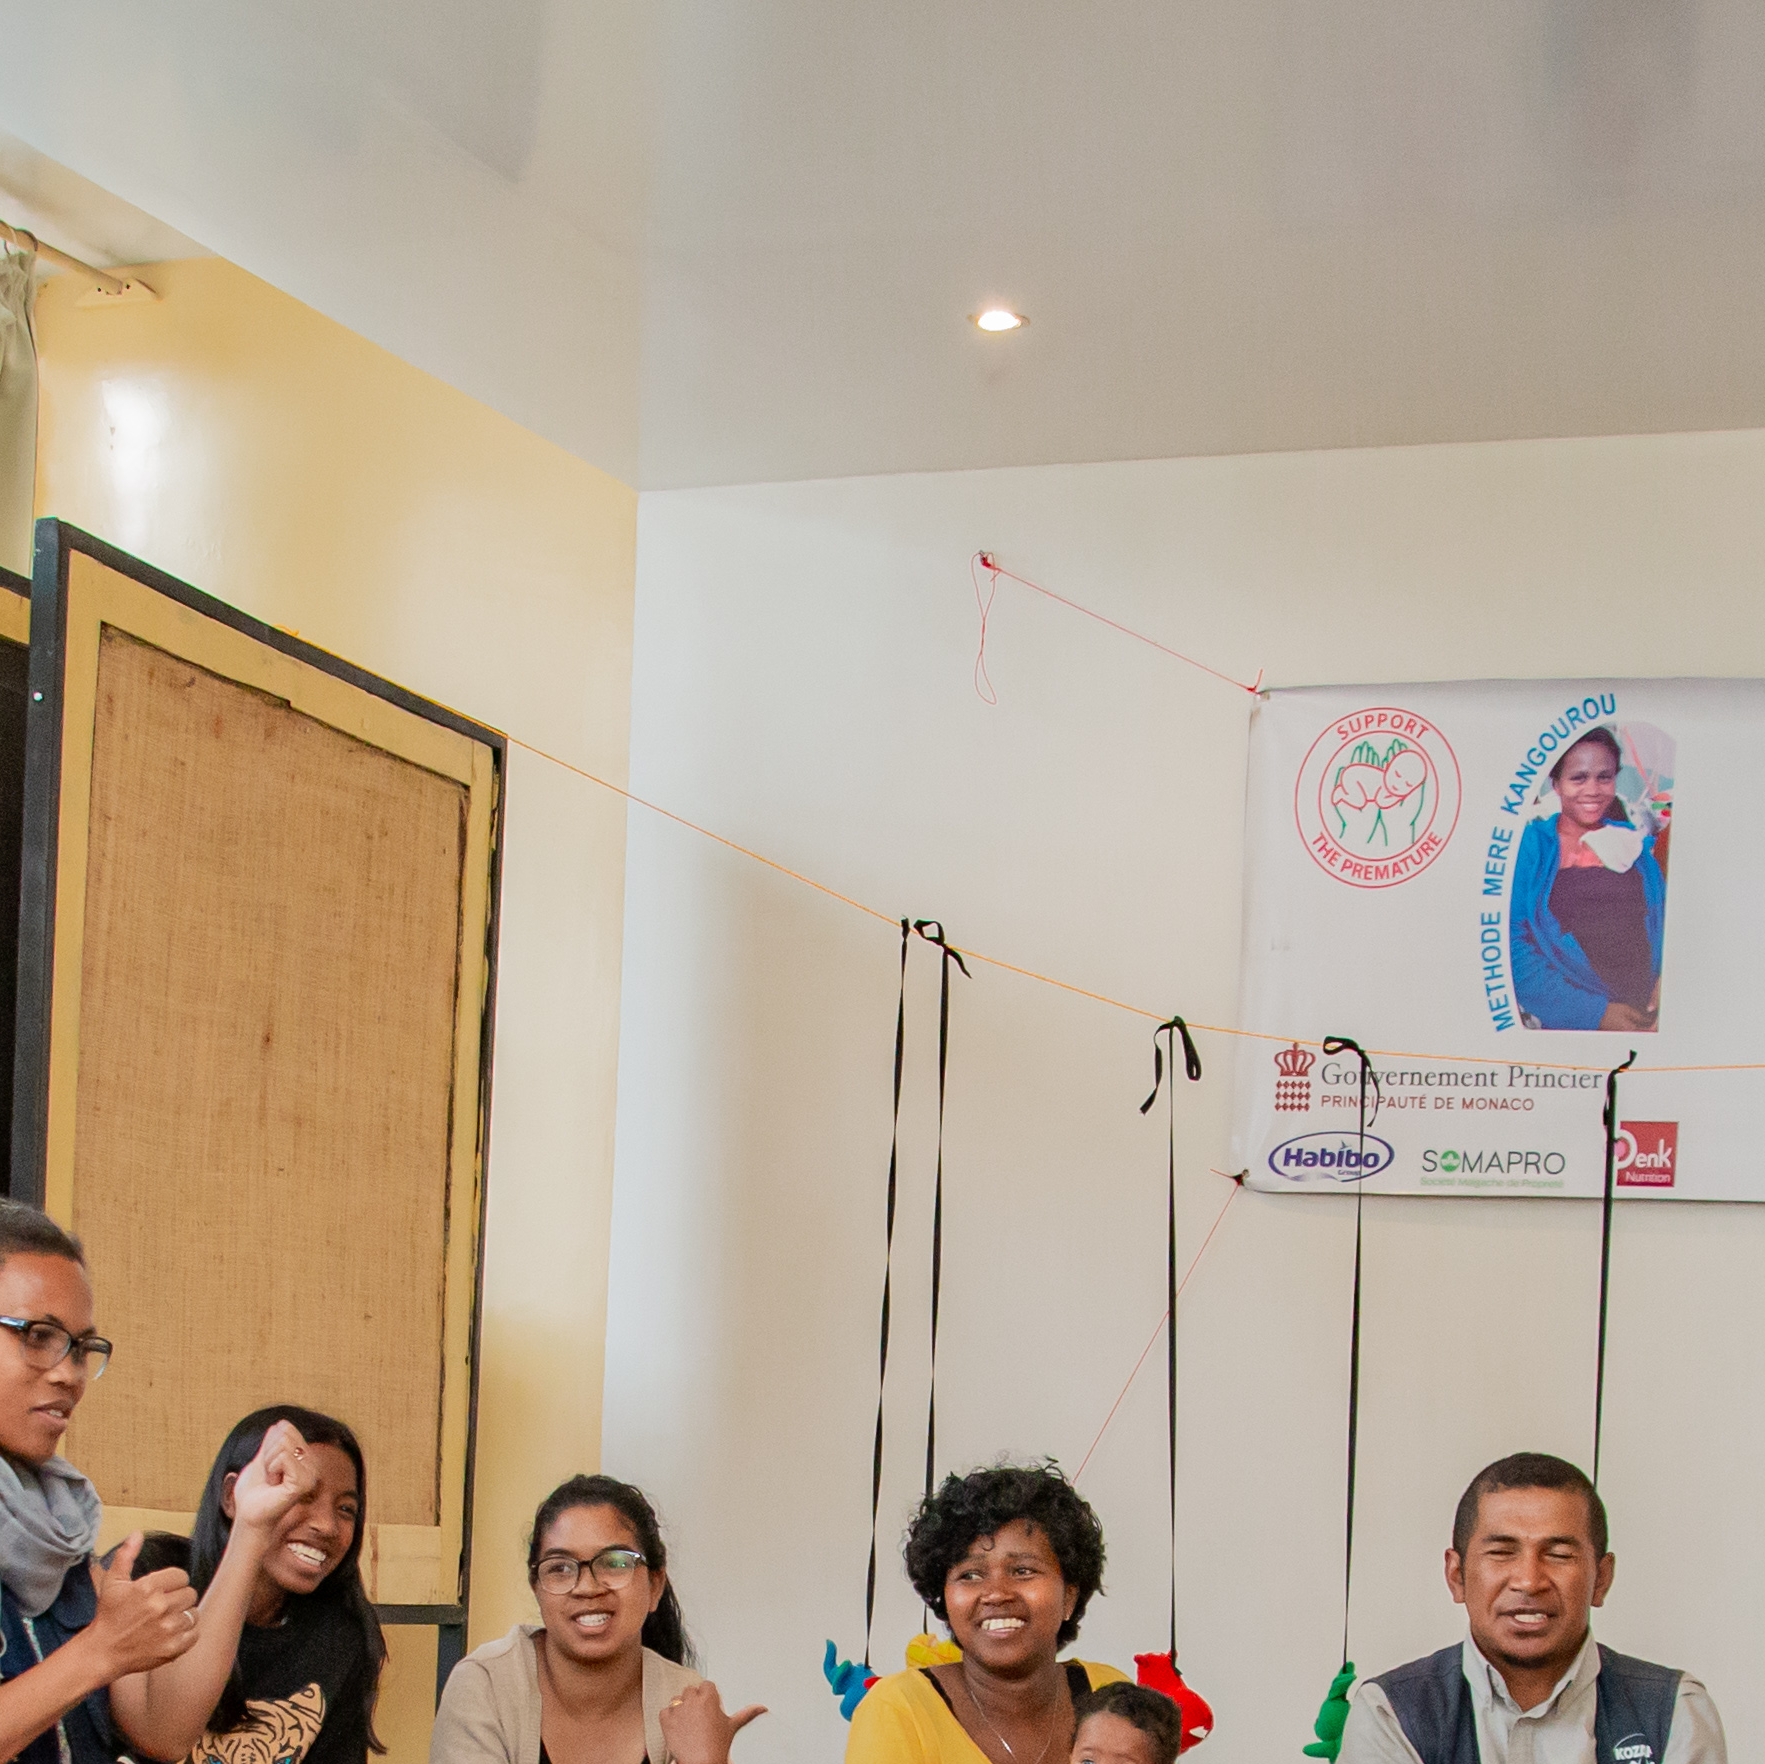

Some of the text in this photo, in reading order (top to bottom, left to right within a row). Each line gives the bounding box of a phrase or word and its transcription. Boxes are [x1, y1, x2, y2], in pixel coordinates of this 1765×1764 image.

[1336, 713, 1430, 741] SUPPORT
[1311, 831, 1443, 882] THE PREMATURE
[1481, 693, 1617, 1032] METHODE MERE KANGOUROU
[1321, 1061, 1603, 1089] Gouvernement Princier
[1320, 1092, 1535, 1112] PRINCIPAUTÉ DE MONACO
[1282, 1146, 1381, 1169] Habibo
[1422, 1149, 1566, 1175] SOMAPRO
